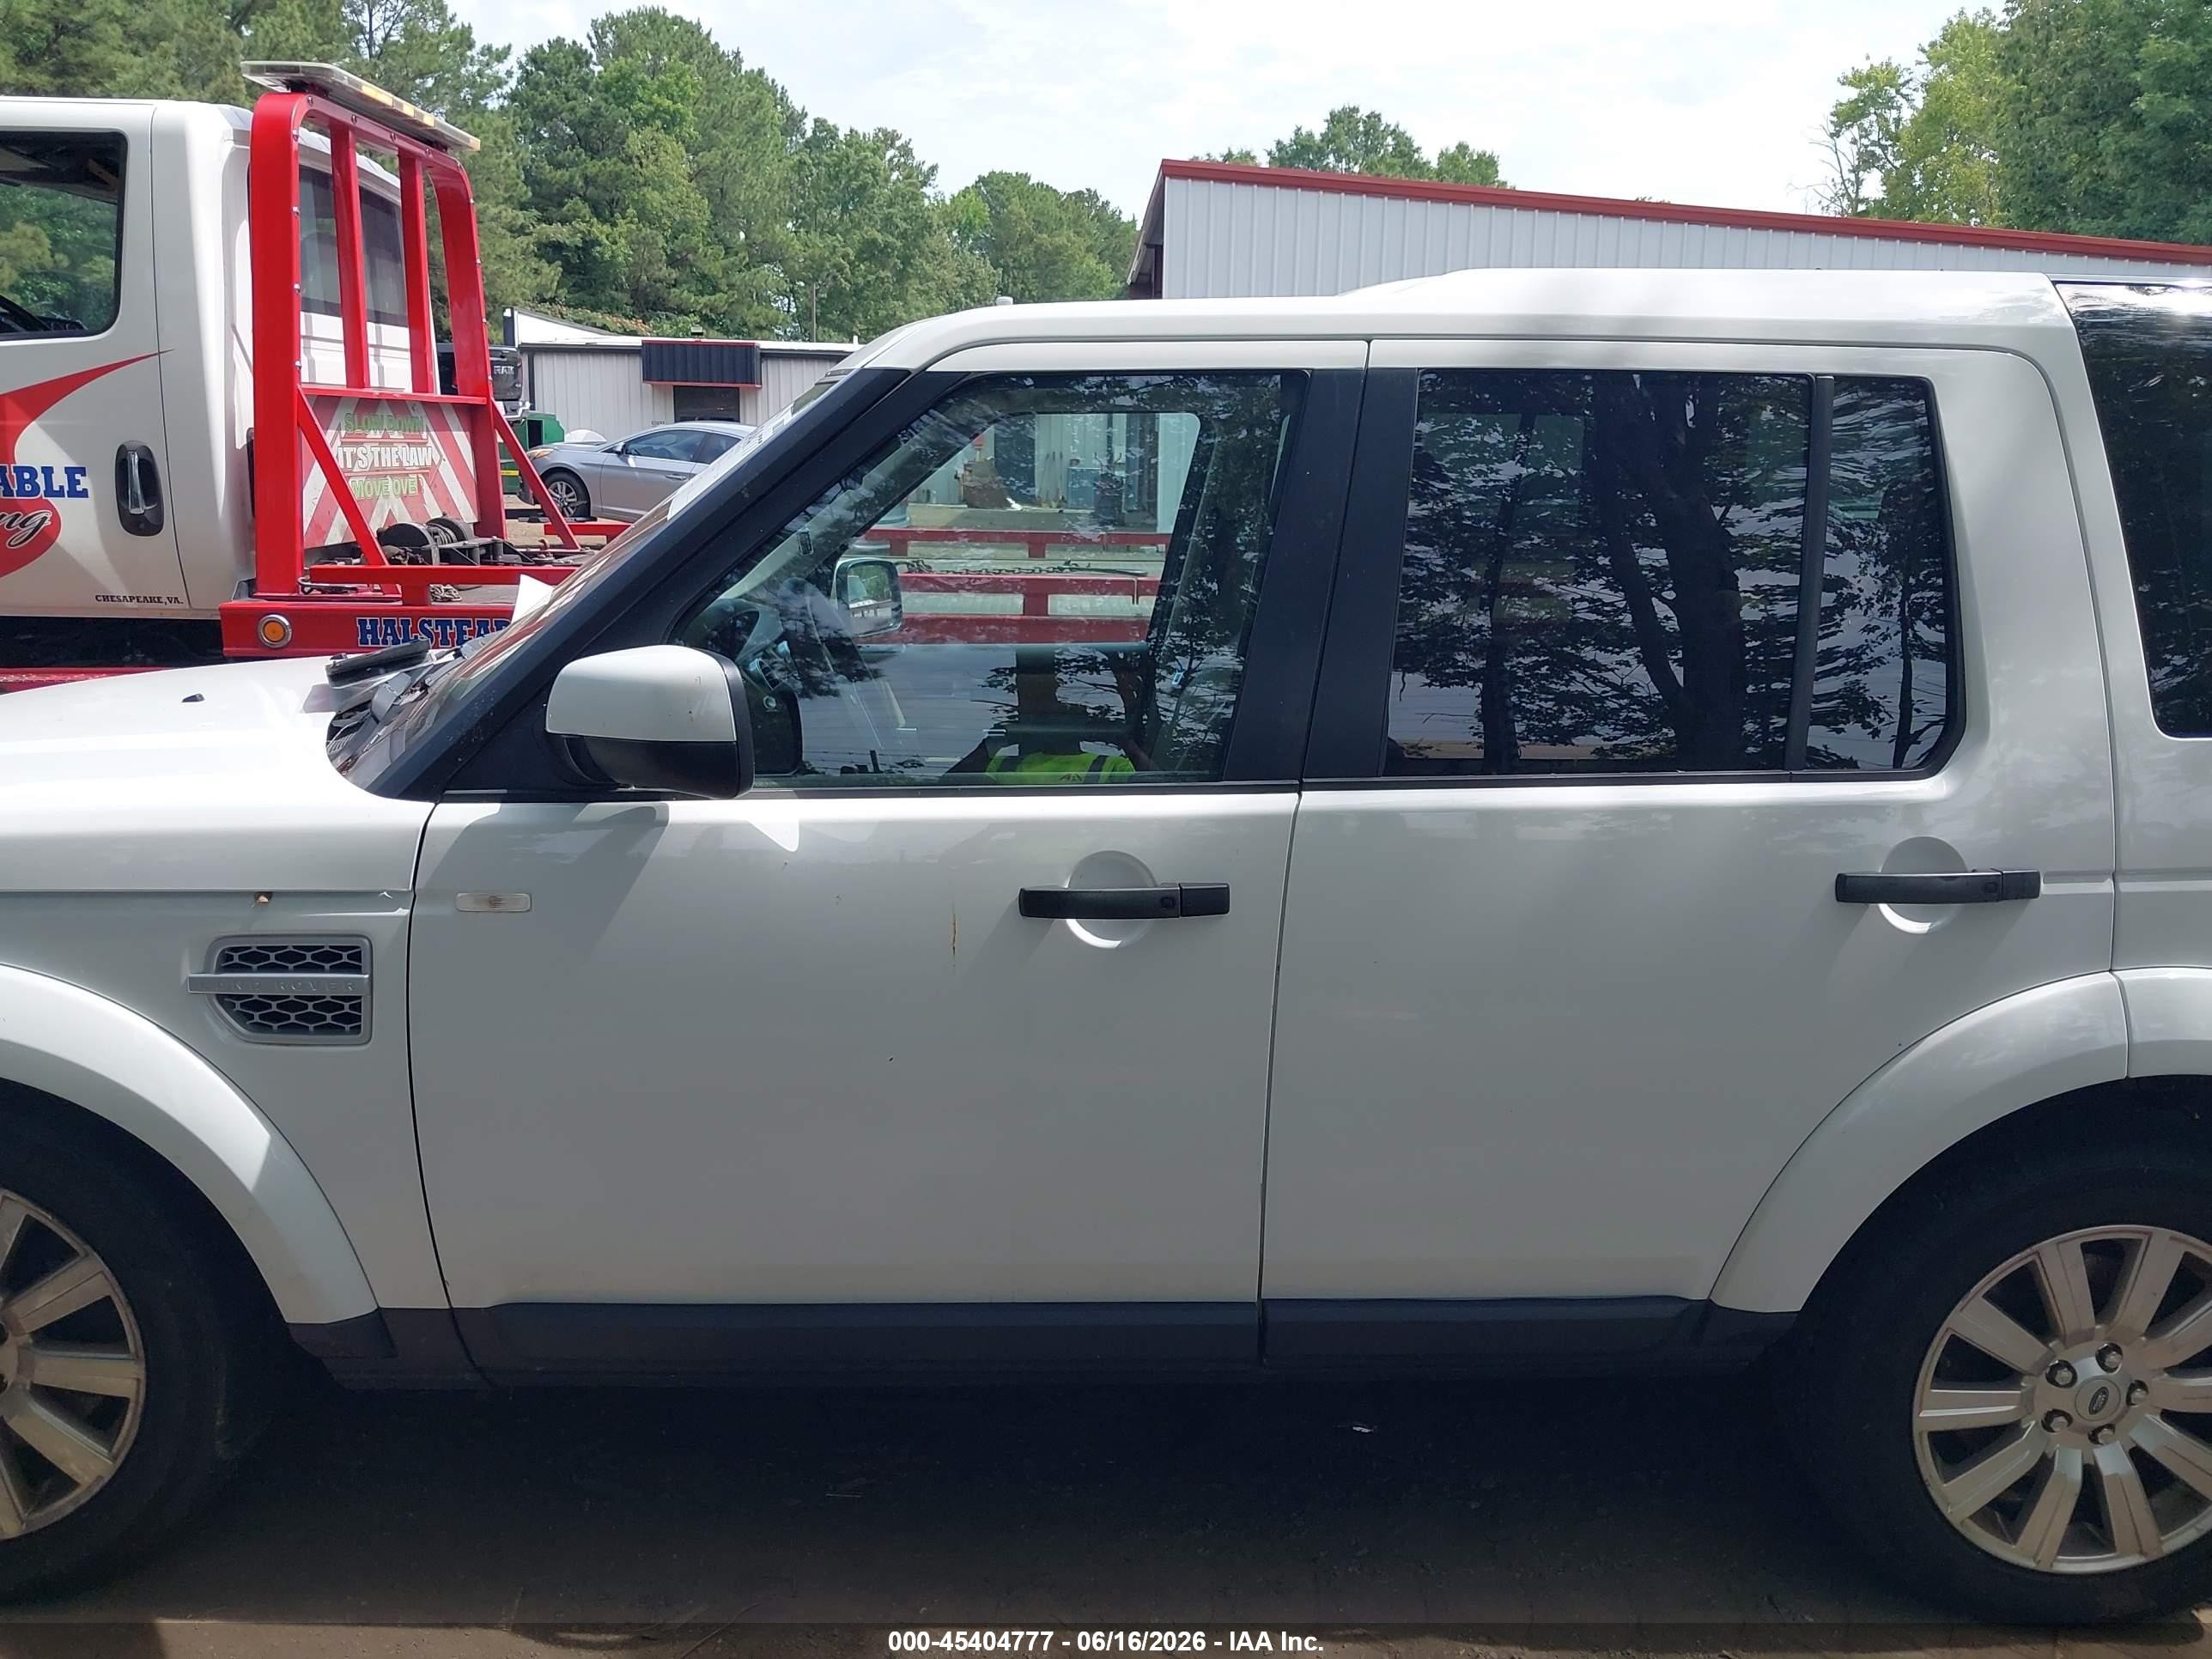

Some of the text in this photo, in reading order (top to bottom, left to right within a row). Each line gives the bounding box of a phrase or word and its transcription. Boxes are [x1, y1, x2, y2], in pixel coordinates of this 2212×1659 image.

[344, 413, 425, 433] SLOW DOWN
[337, 446, 432, 469] IT'S THE LAW
[350, 478, 392, 499] MOVE
